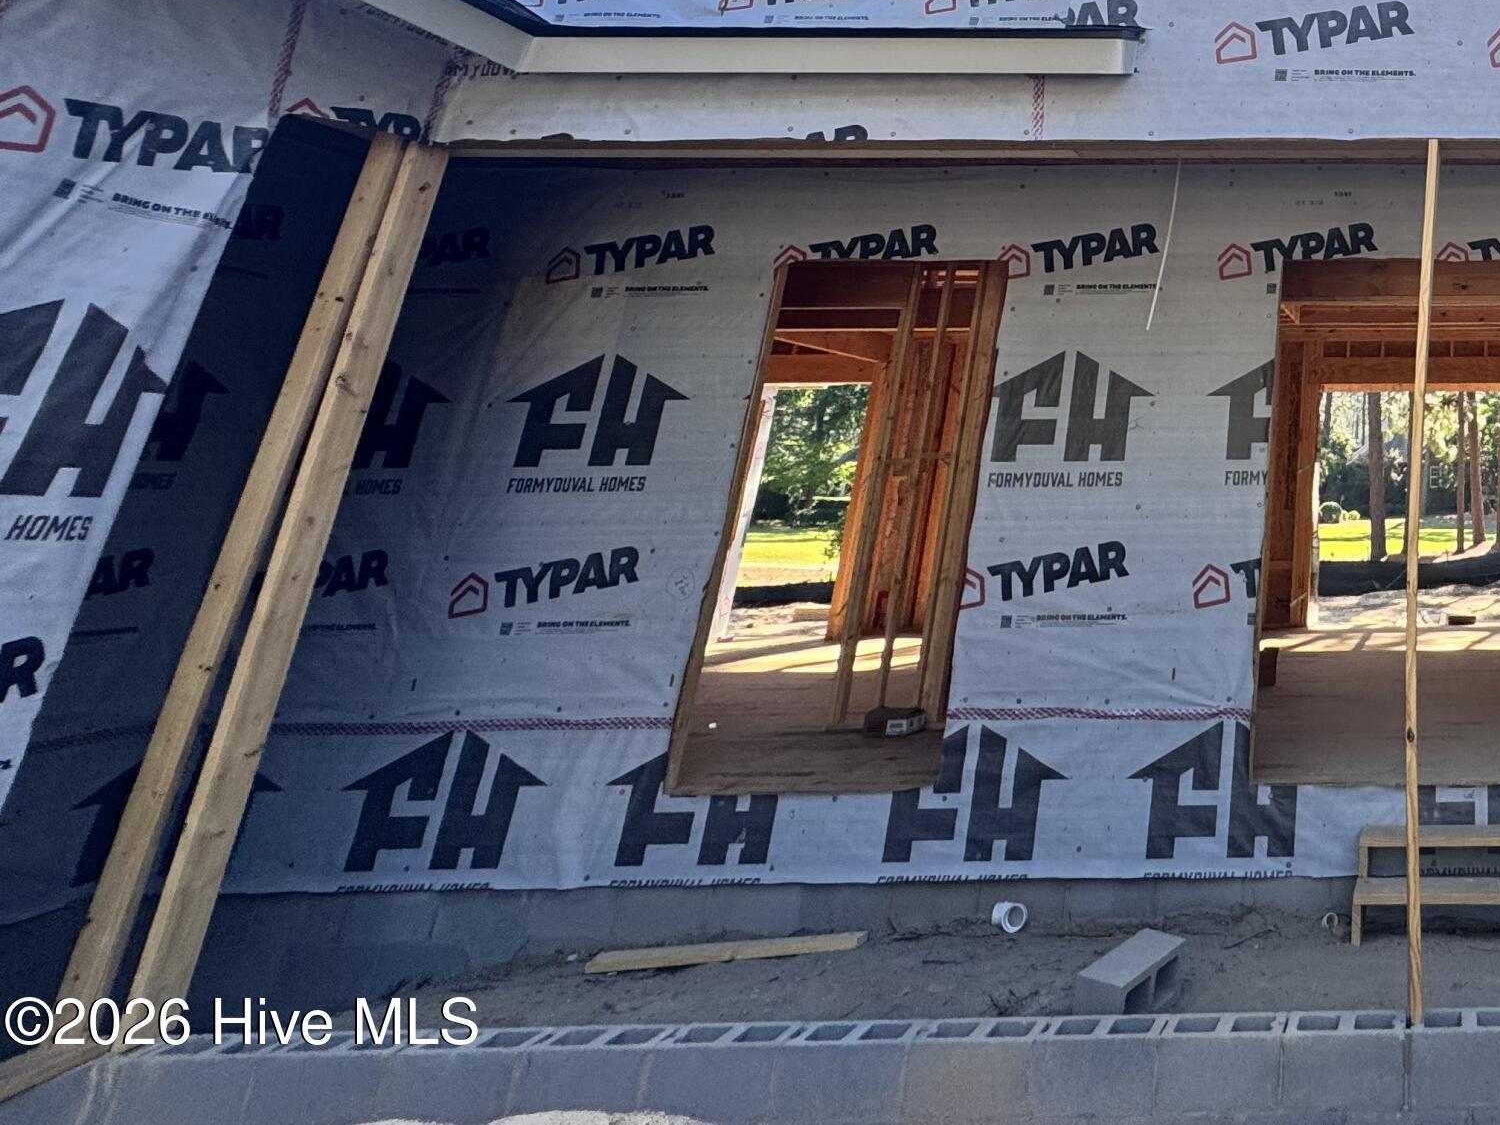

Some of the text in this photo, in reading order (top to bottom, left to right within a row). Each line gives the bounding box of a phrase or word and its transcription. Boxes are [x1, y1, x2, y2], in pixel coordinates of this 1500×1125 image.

[1256, 1, 1415, 55] TYPAR
[112, 192, 150, 209] BRING
[152, 202, 172, 213] ON
[584, 224, 715, 275] TYPAR
[1030, 223, 1160, 273] TYPAR
[356, 479, 402, 495] HOMES
[507, 476, 647, 493] FORMYDUVAL HOMES
[987, 471, 1123, 488] FORMYDUVAL HOMES
[4, 515, 93, 542] HOMES
[494, 546, 640, 608] TYPAR
[987, 540, 1130, 601] TYPAR
